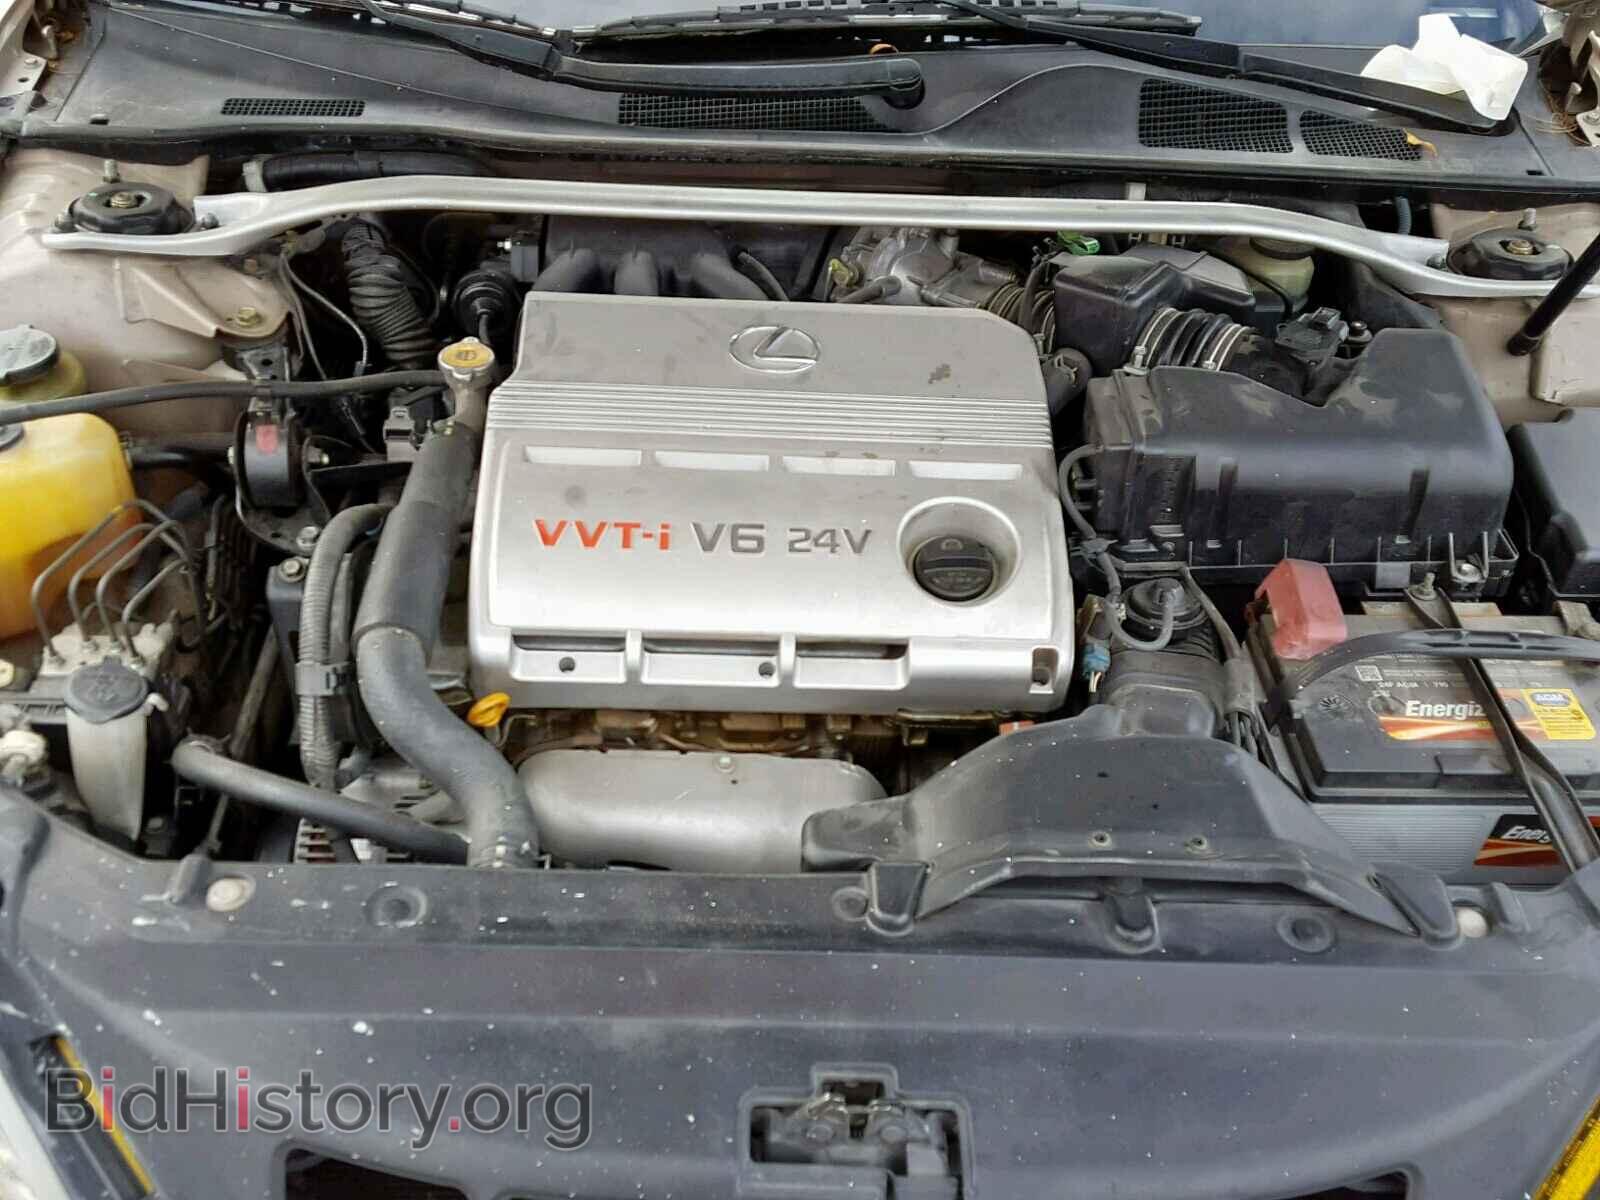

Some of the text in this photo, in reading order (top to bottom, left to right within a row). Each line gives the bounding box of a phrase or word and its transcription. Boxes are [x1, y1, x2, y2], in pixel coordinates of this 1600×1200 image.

[534, 519, 873, 556] VVT-i V6 24V
[1405, 699, 1487, 721] Energiz
[1500, 824, 1553, 845] Energ
